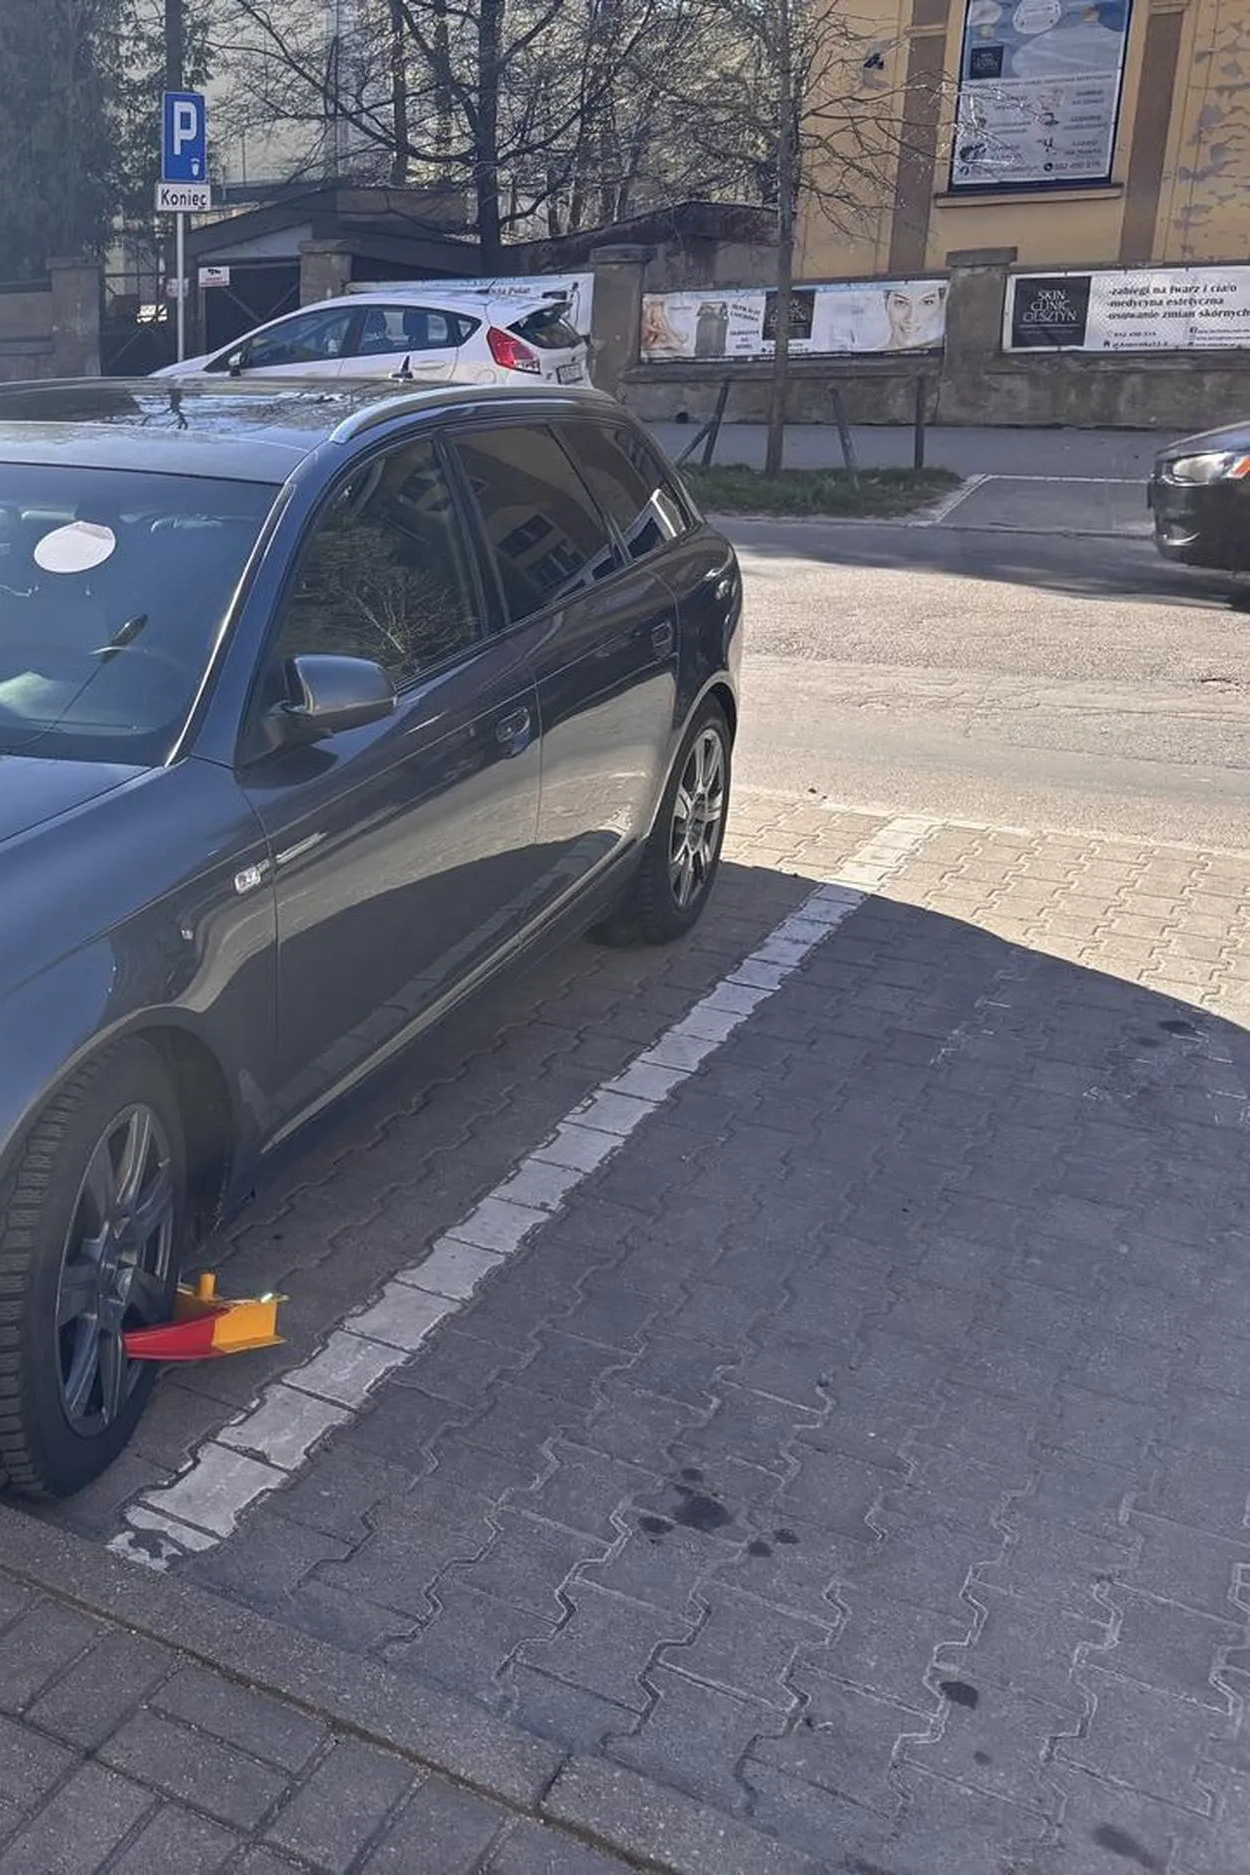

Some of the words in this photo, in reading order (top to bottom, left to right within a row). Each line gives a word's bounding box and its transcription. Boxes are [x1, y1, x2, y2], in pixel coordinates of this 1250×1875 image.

[173, 101, 197, 155] P
[161, 189, 207, 206] Koniec
[1037, 289, 1066, 300] SKIN
[1153, 286, 1167, 294] na
[1170, 285, 1200, 294] twarz
[1030, 300, 1070, 311] CLINIC
[1166, 297, 1224, 308] estetyczna
[1023, 311, 1077, 322] OLSZTYN
[1162, 309, 1195, 318] zmian
